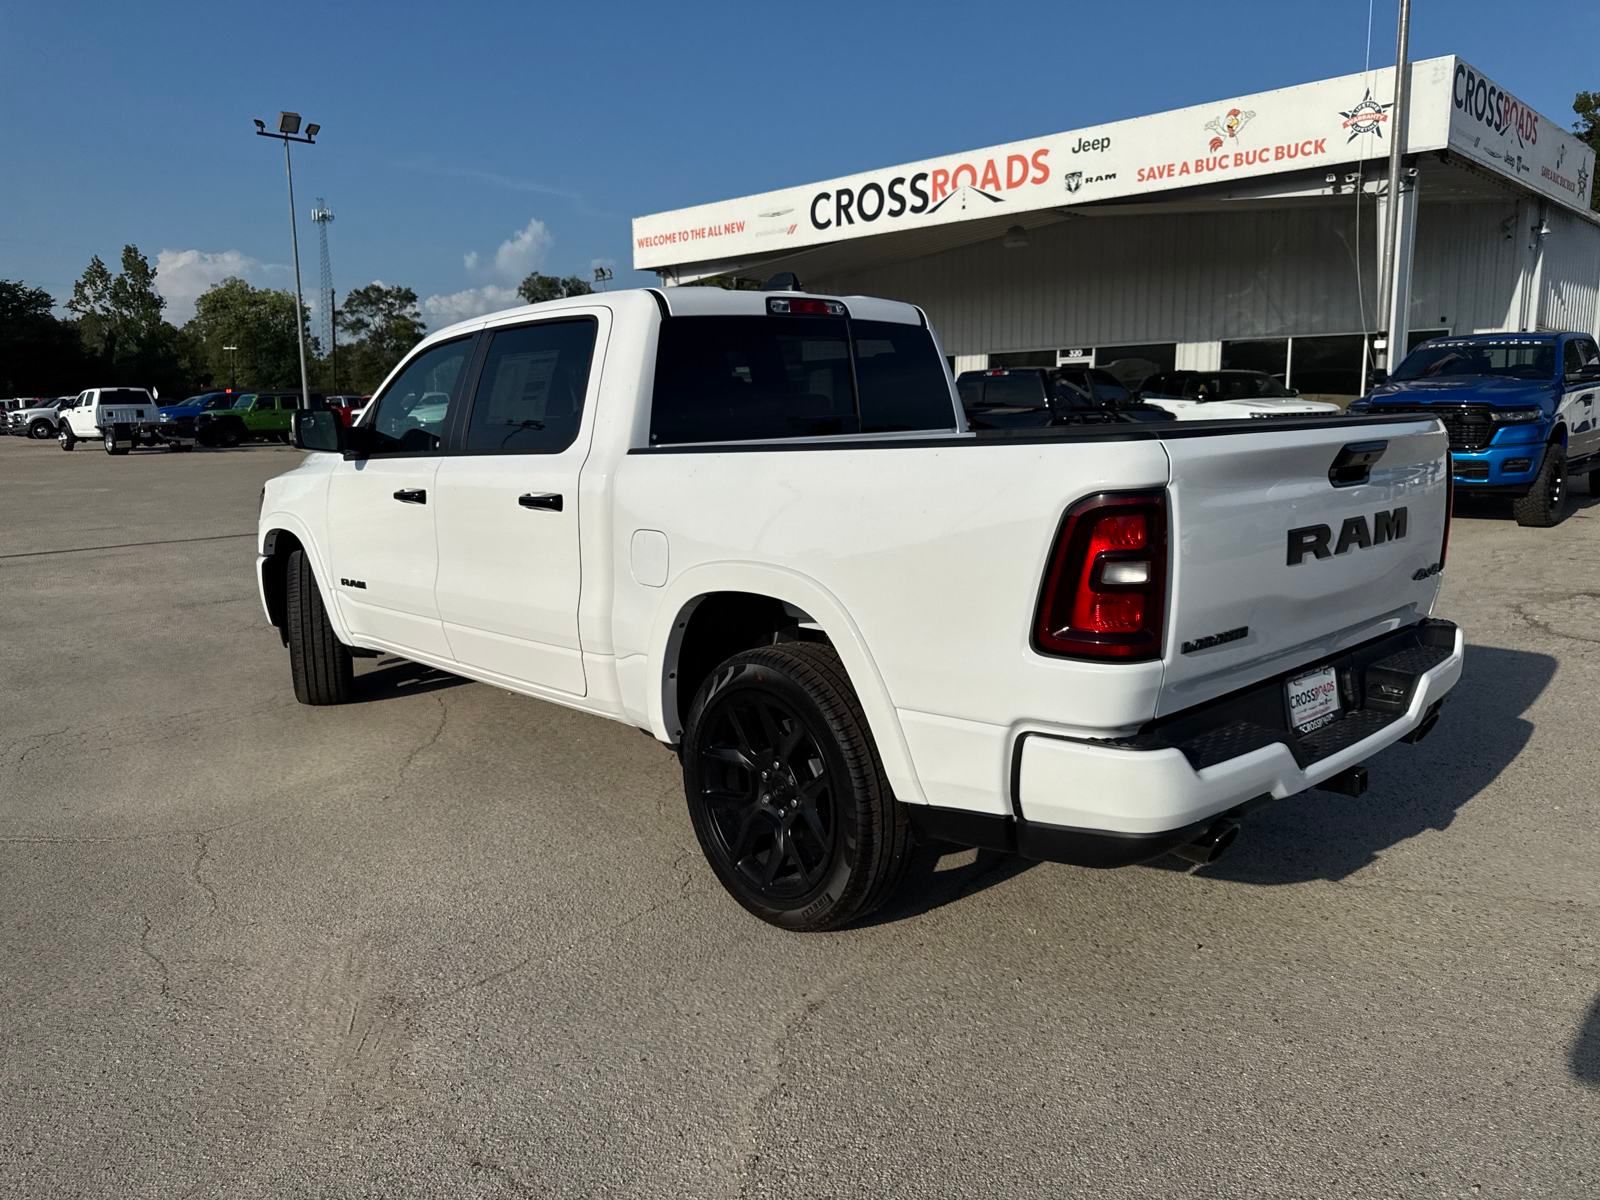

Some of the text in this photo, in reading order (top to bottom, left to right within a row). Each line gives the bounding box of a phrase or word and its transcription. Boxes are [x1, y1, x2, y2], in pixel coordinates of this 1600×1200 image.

[1453, 64, 1538, 145] CROSSROADS
[1346, 113, 1385, 125] WARRANTY
[1072, 137, 1110, 153] Jeep
[1137, 138, 1326, 182] SAVE A BUC BUC BUCK
[810, 149, 1050, 230] CROSSROADS
[1085, 173, 1116, 184] RAM
[637, 232, 677, 249] WELCOME
[678, 230, 689, 242] TO
[690, 227, 706, 240] THE
[707, 225, 722, 237] ALL
[723, 221, 745, 234] NEW
[1069, 349, 1083, 358] 320
[1286, 506, 1408, 566] RAM
[340, 578, 367, 589] RAM
